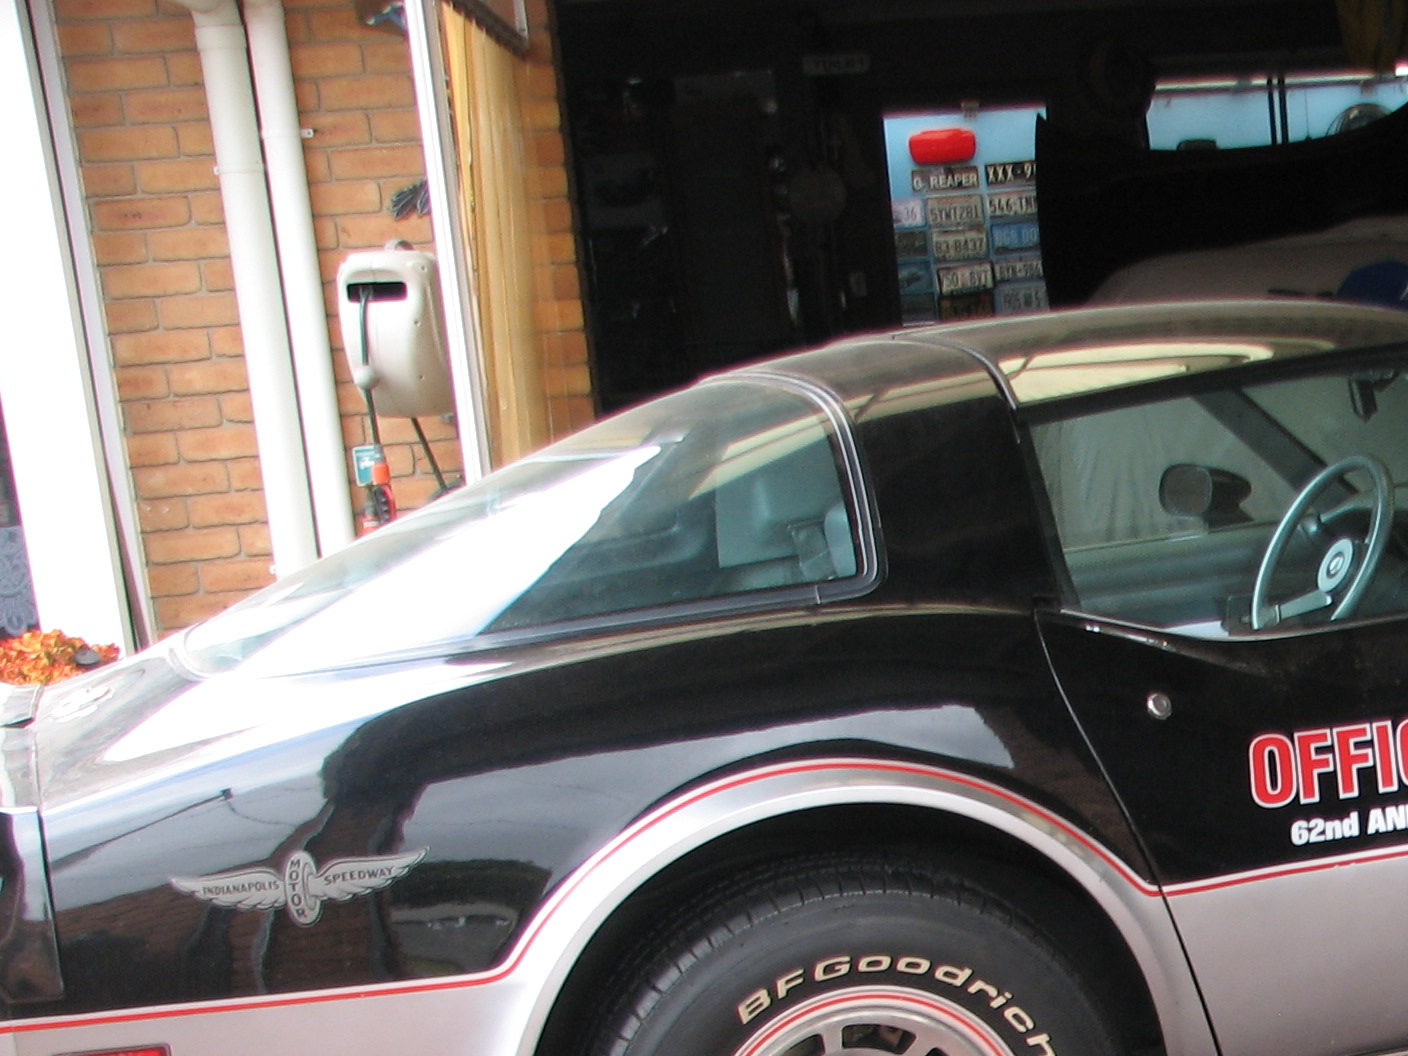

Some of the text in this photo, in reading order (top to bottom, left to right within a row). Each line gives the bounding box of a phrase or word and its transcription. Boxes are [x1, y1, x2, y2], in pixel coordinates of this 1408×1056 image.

[930, 172, 978, 189] REAPER
[1290, 816, 1360, 845] 62nd
[324, 865, 396, 886] SPEEDWAY
[202, 880, 280, 897] INDIANAPOLIS
[289, 859, 307, 918] MOTOR
